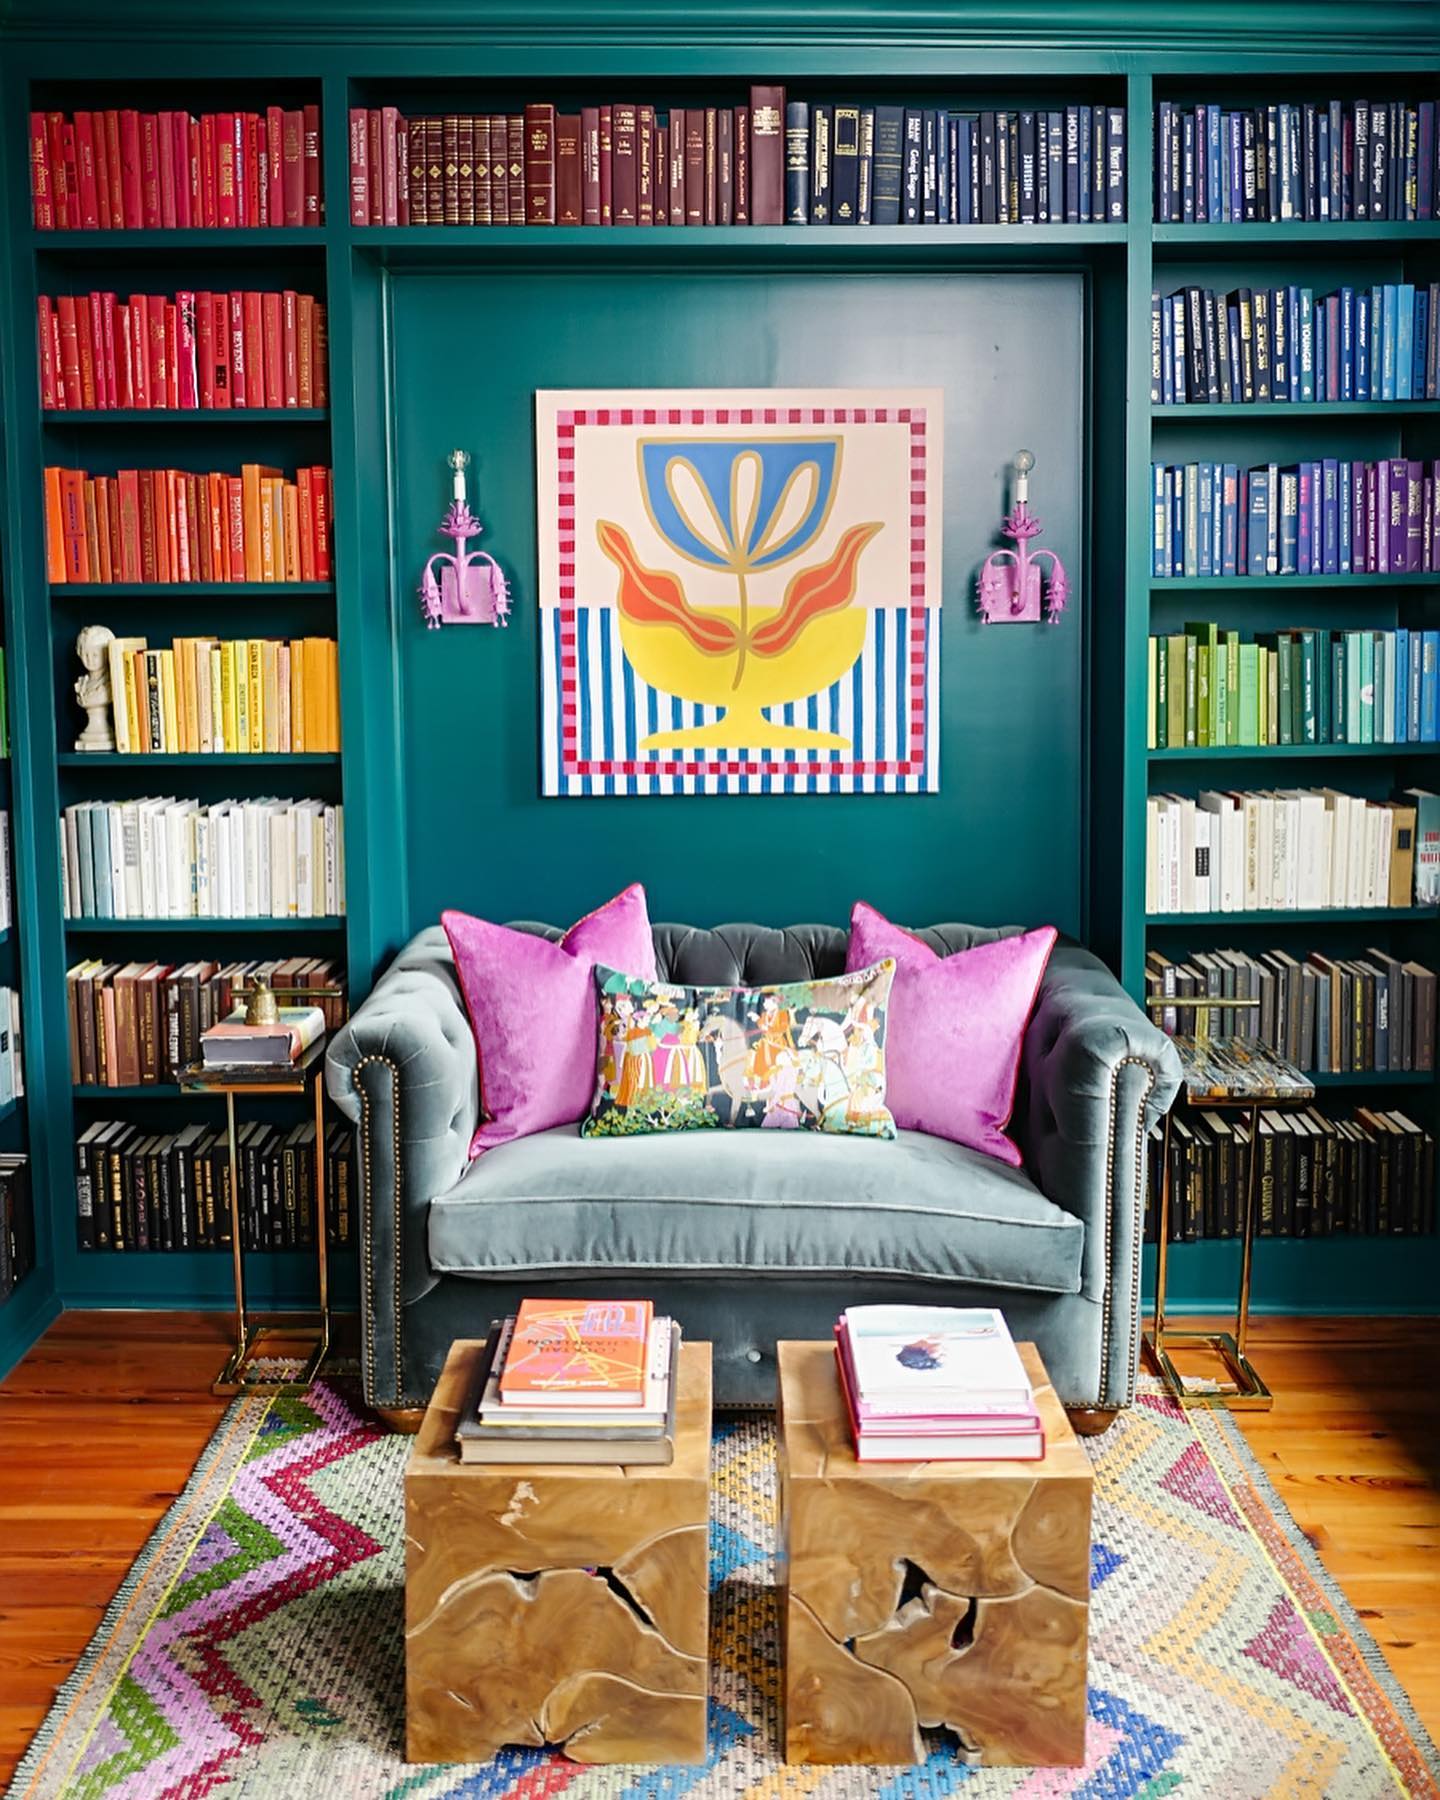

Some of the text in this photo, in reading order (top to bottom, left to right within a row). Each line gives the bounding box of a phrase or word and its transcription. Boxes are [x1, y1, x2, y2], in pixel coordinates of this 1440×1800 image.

[1067, 114, 1078, 150] HODA
[907, 149, 919, 199] Going Rogue
[1023, 154, 1034, 191] DISTANCE
[1374, 143, 1385, 194] Going Rogue
[1152, 320, 1161, 338] NOT
[1302, 323, 1312, 372] YOUNGER
[234, 331, 243, 374] REVENGE
[1152, 355, 1161, 379] WHO?
[230, 496, 243, 552] PHOENIX
[262, 503, 271, 529] SAND
[169, 1012, 179, 1064] TUMBLEDOWN
[1261, 1175, 1274, 1221] GUARDIAN
